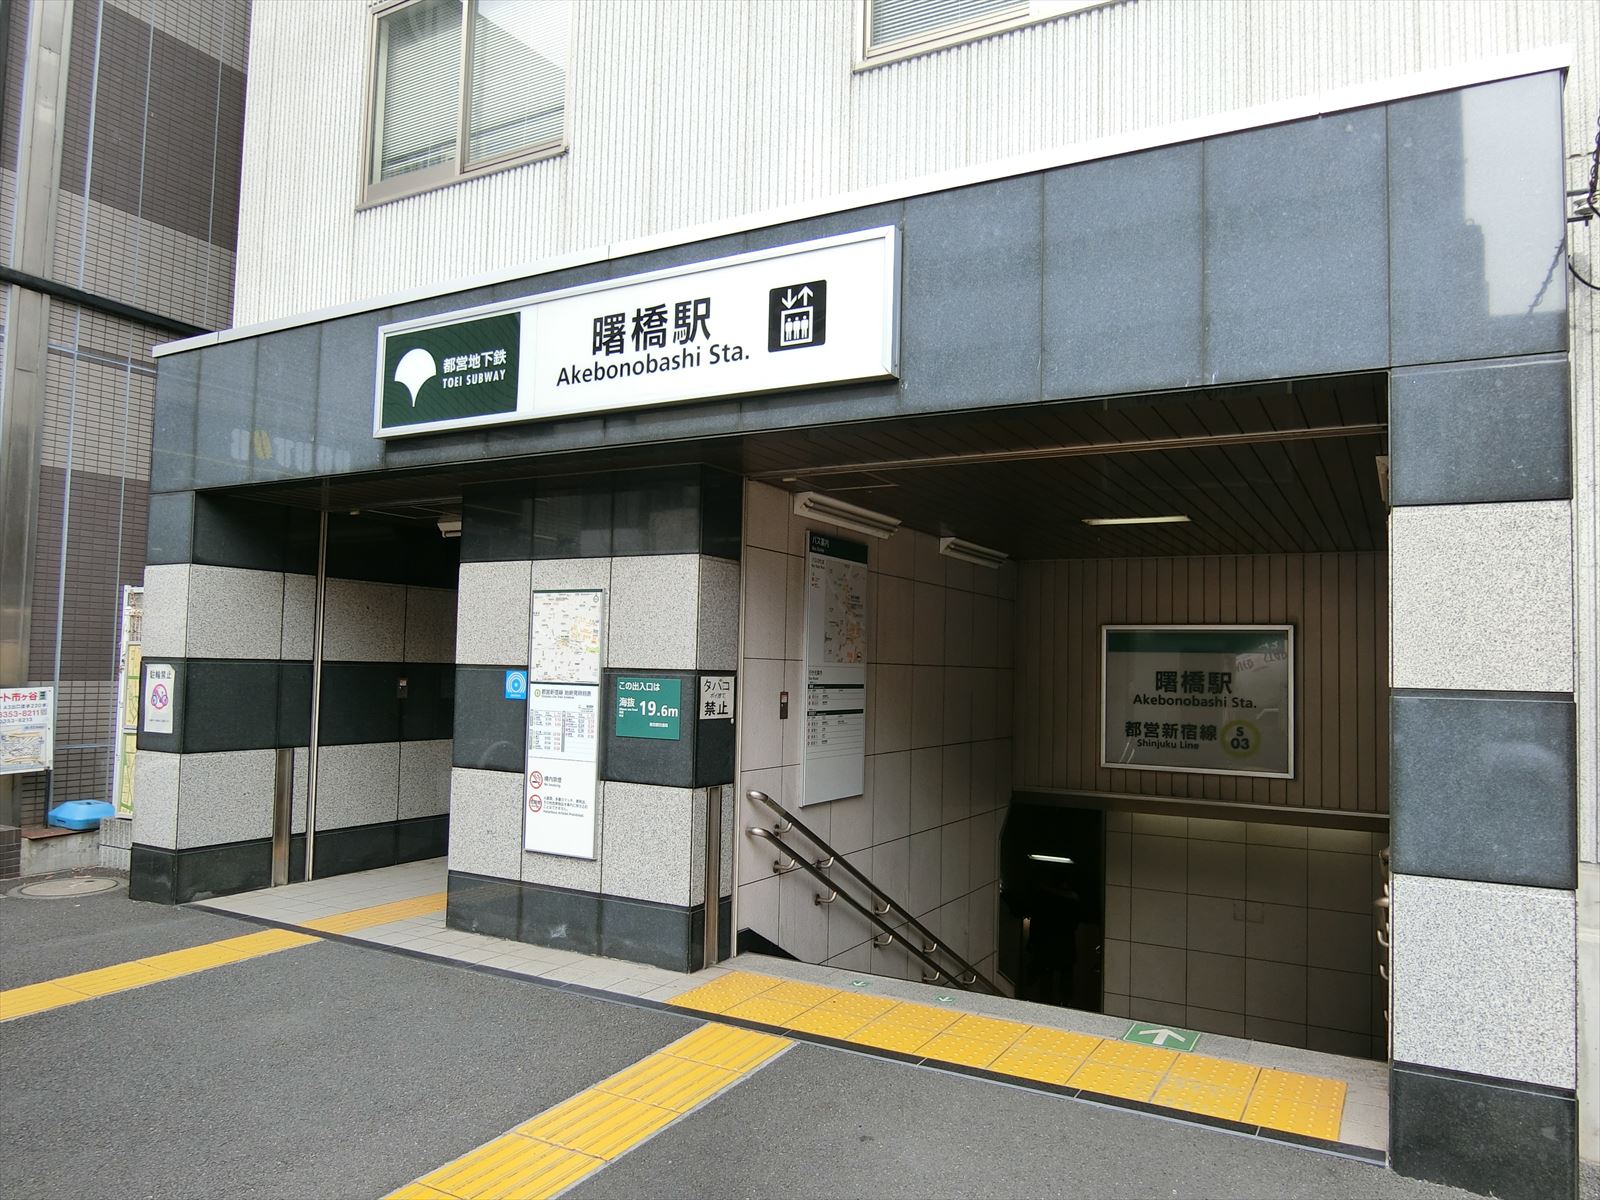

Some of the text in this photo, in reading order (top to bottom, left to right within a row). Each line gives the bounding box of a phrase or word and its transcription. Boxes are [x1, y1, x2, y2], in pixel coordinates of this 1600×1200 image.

[592, 297, 711, 356] 曙橋駅
[443, 350, 507, 373] 都営地下鉄
[556, 344, 750, 387] Akebonobashi Sta.
[443, 369, 507, 390] TOEI SUBWAY
[618, 681, 661, 692] この出入口は
[703, 678, 730, 692] タバコ
[1155, 670, 1232, 695] 曙橋駅
[618, 697, 636, 708] 海抜
[639, 700, 679, 717] 19.6m
[704, 701, 729, 716] 禁止
[1133, 693, 1257, 709] Akebonobashi Sta.
[1125, 721, 1217, 742] 都営新宿線
[1236, 727, 1244, 737] S
[1137, 738, 1200, 750] Shinjuku Line
[1230, 738, 1250, 750] 03
